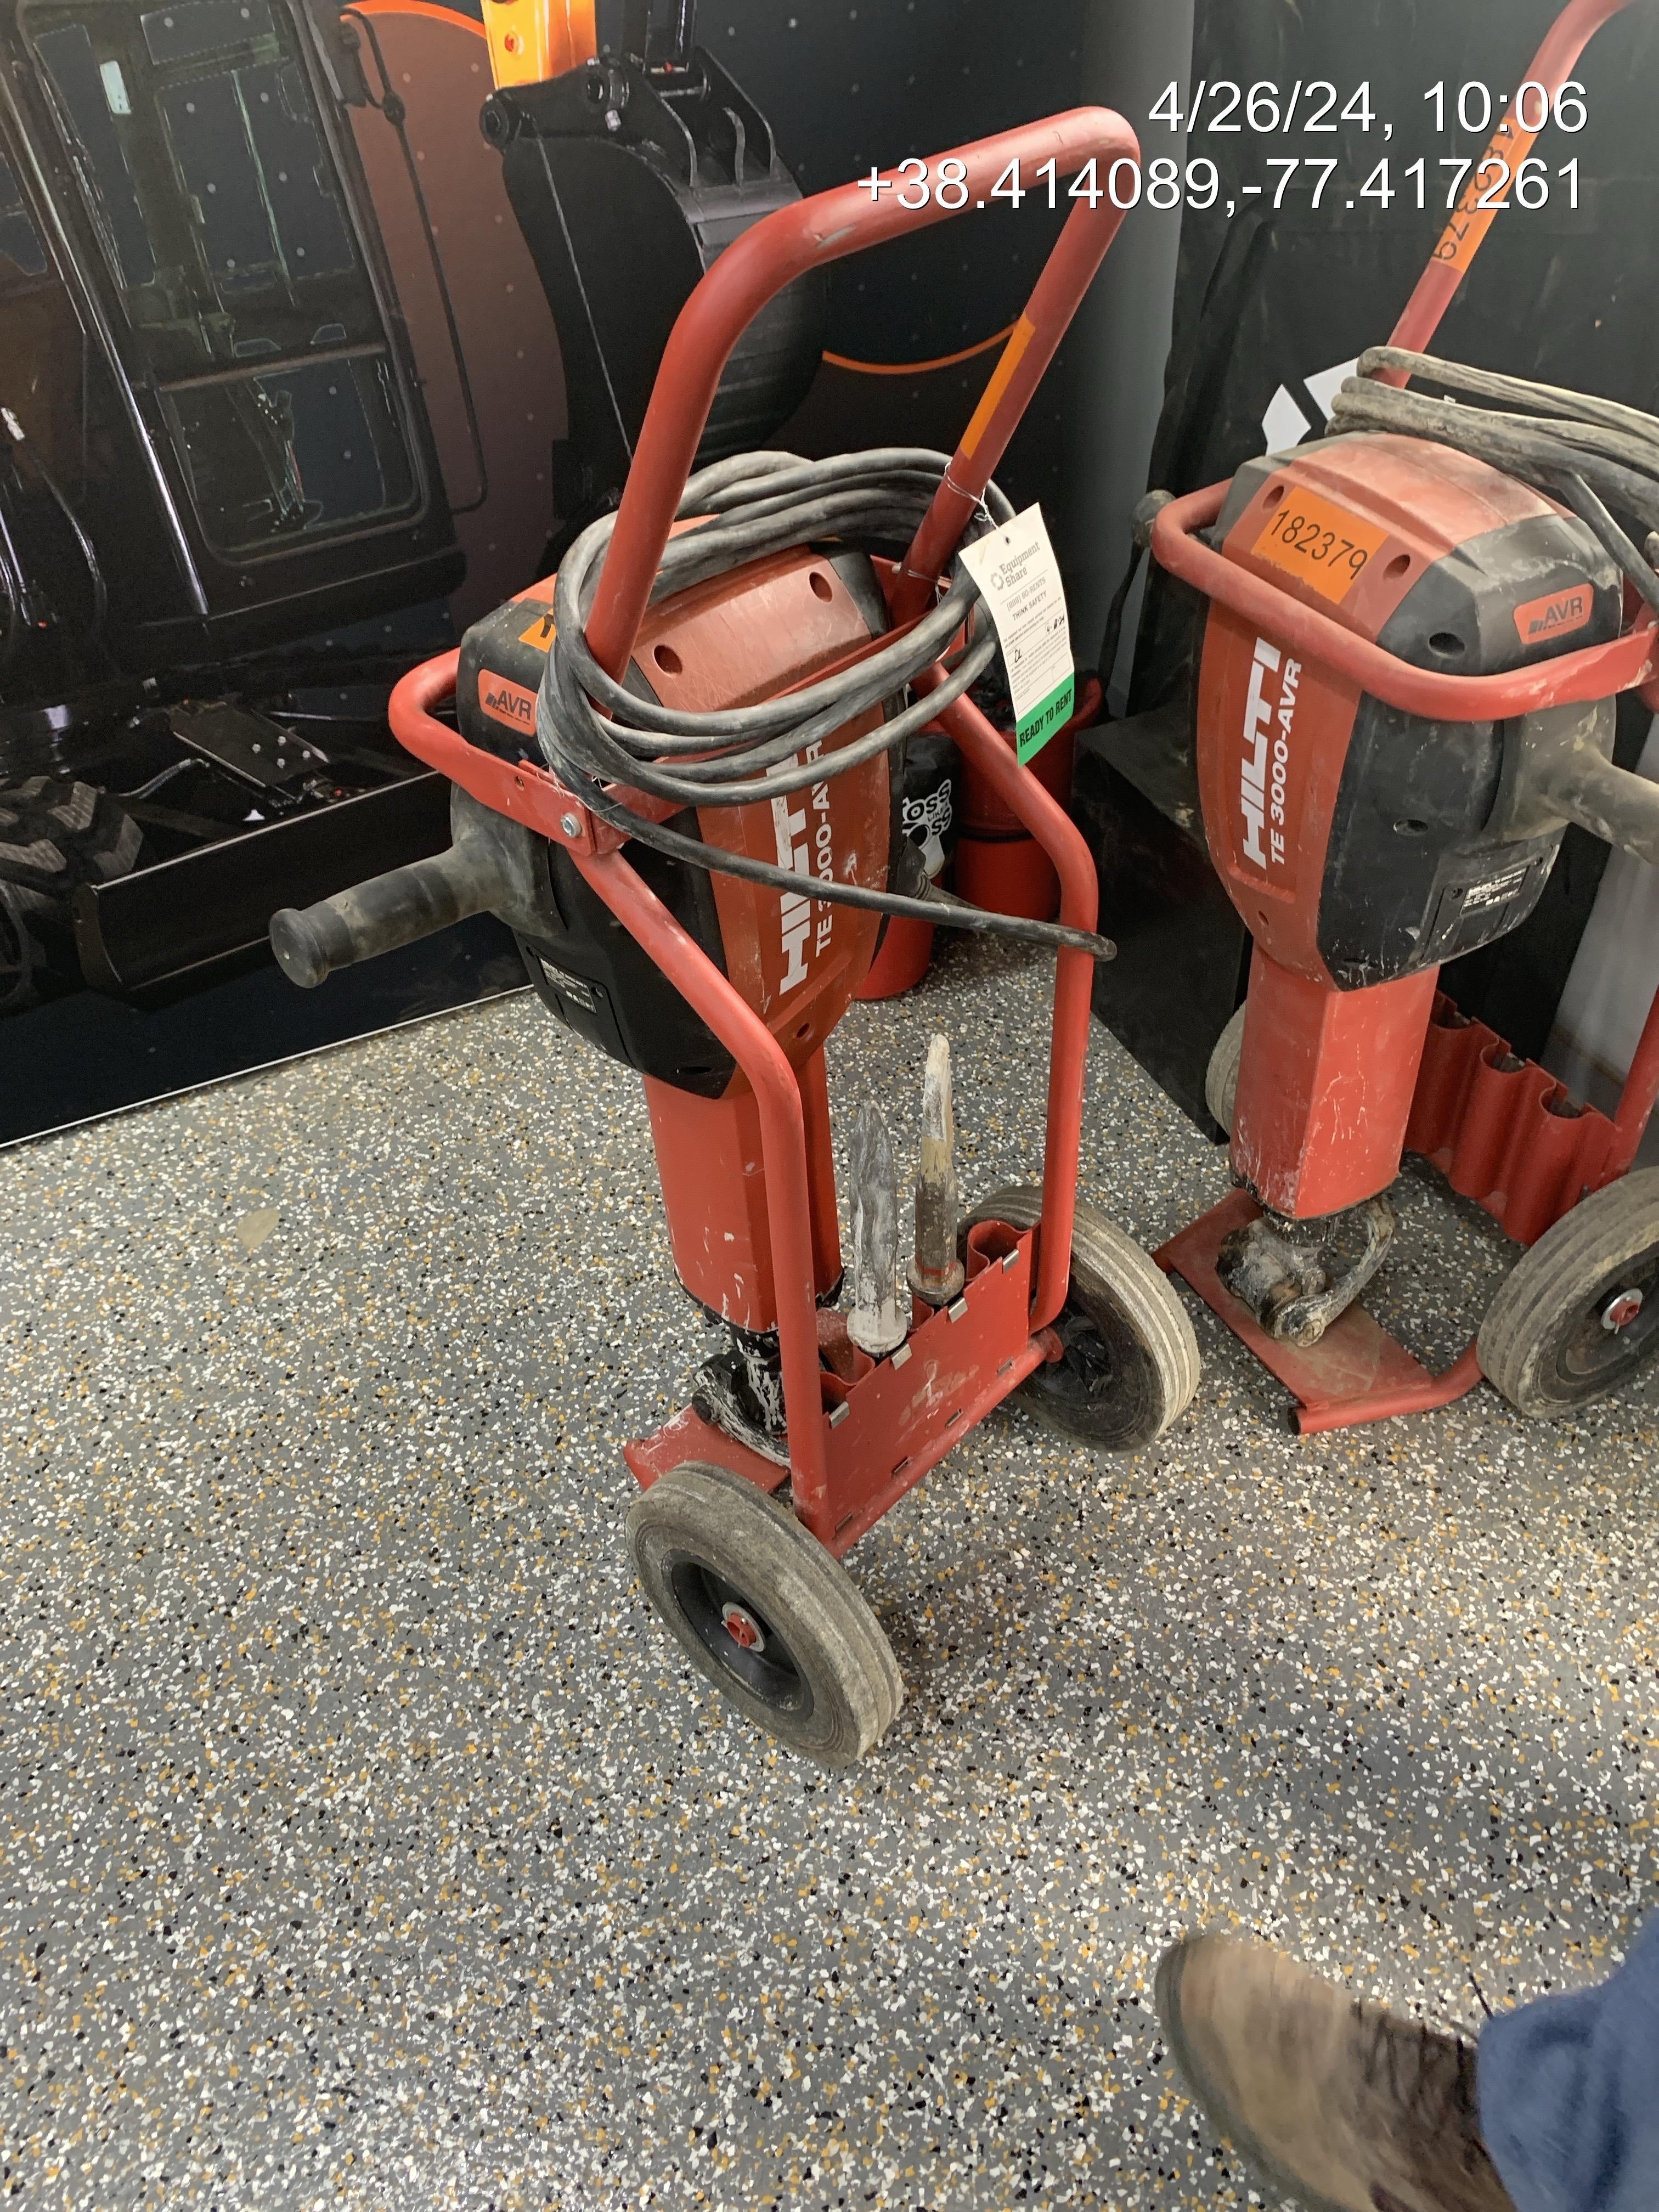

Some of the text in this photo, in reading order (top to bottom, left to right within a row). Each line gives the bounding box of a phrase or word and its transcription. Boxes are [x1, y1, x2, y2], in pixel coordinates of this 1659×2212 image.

[999, 541, 1040, 575] Equipment
[1271, 509, 1368, 580] 182379
[1005, 566, 1028, 588] Share
[1012, 590, 1047, 621] THINK SAFETY
[1543, 596, 1583, 623] AVR
[498, 690, 532, 720] AVR
[1019, 715, 1044, 748] READY
[1046, 707, 1054, 725] TO
[1056, 689, 1072, 716] RENT
[1240, 636, 1282, 871] HILTI
[1270, 658, 1302, 865] TE 3000-AVR
[815, 914, 833, 957] TE
